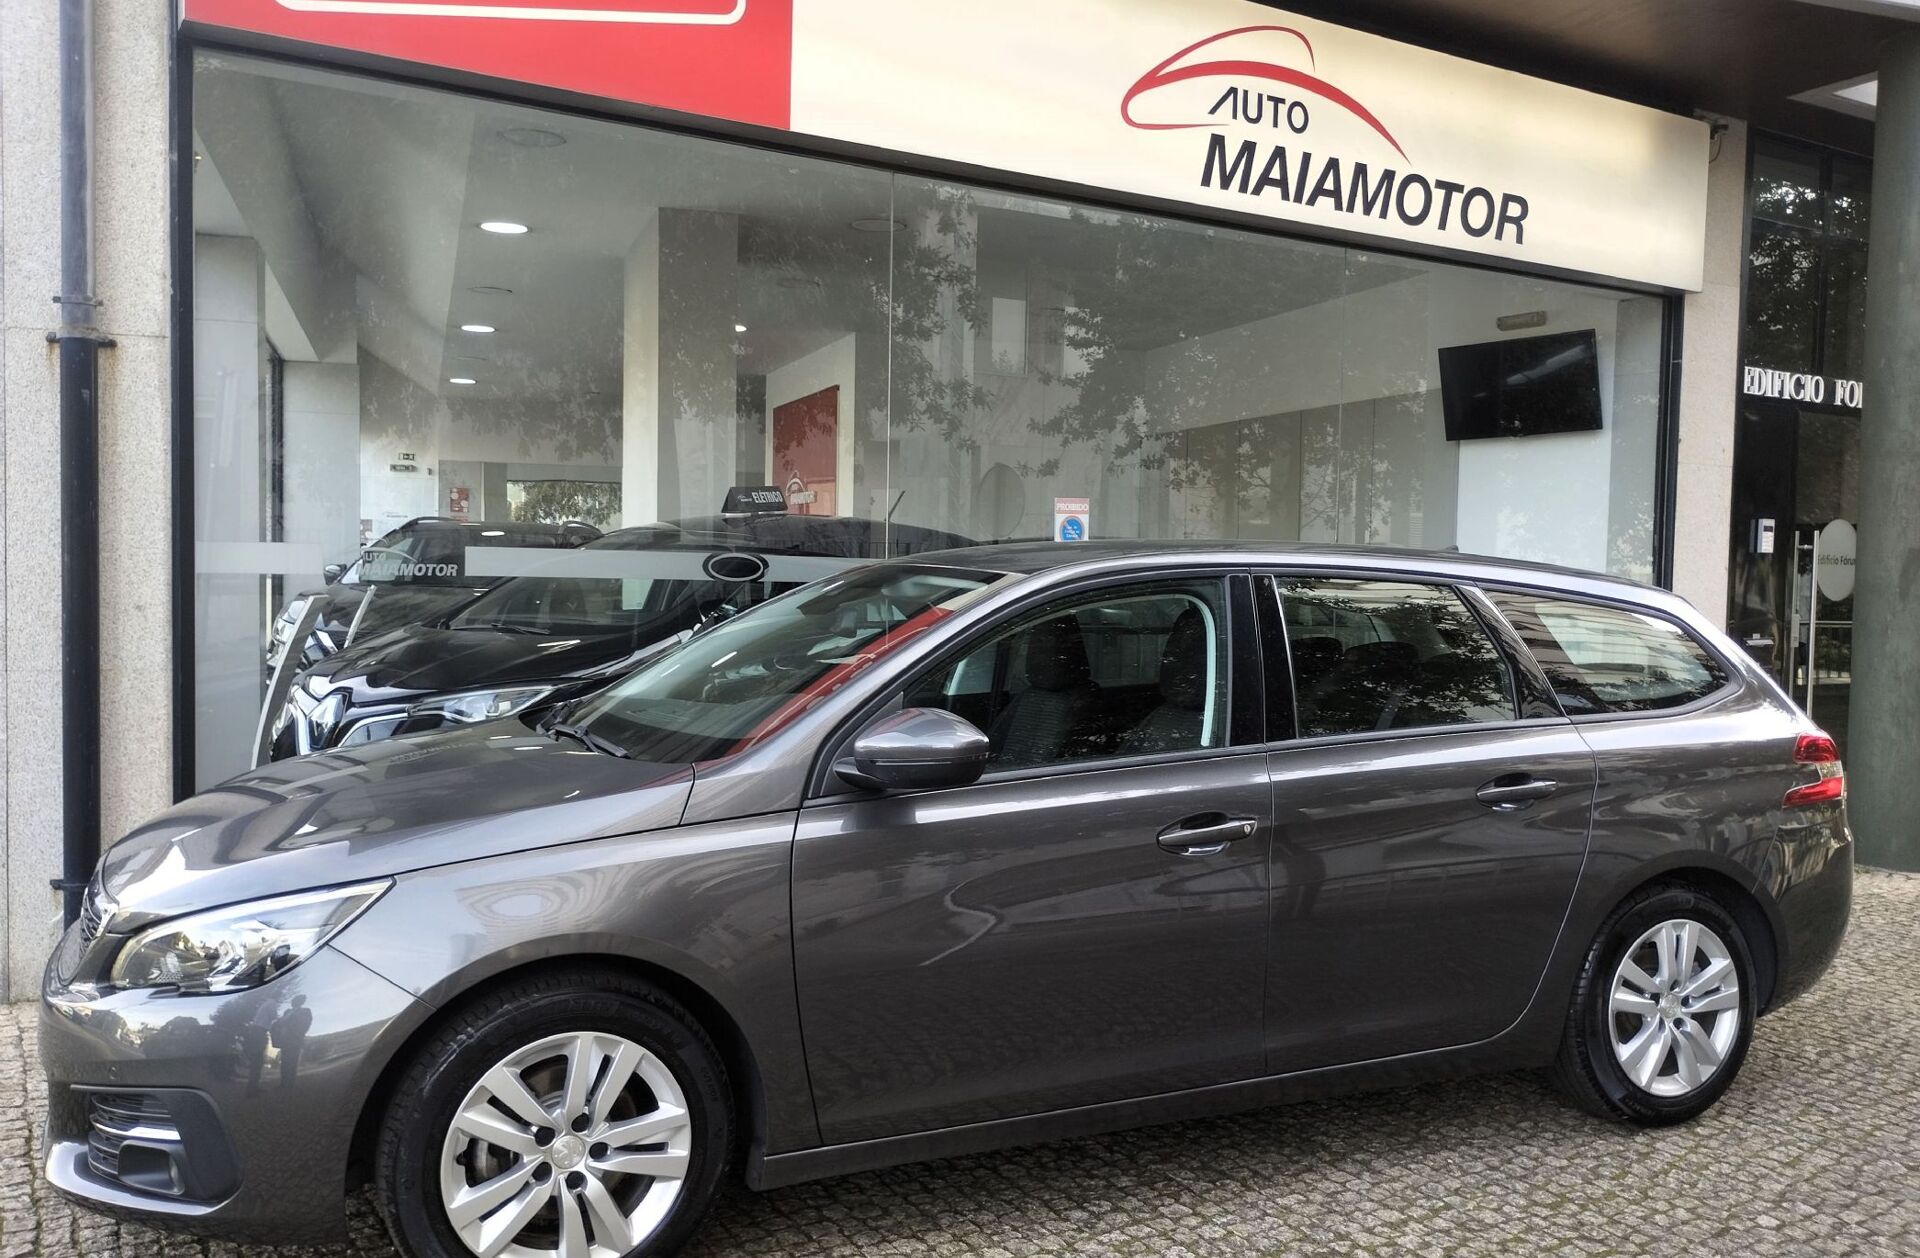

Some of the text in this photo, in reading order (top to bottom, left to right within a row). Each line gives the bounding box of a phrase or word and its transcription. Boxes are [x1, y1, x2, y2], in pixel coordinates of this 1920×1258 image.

[1208, 86, 1309, 134] AUTO
[1200, 133, 1529, 245] MAIAMOTOR
[1743, 366, 1825, 404] EDIFICIO
[1055, 503, 1089, 511] PROIBIDO
[356, 563, 459, 577] MAIAMOTOR
